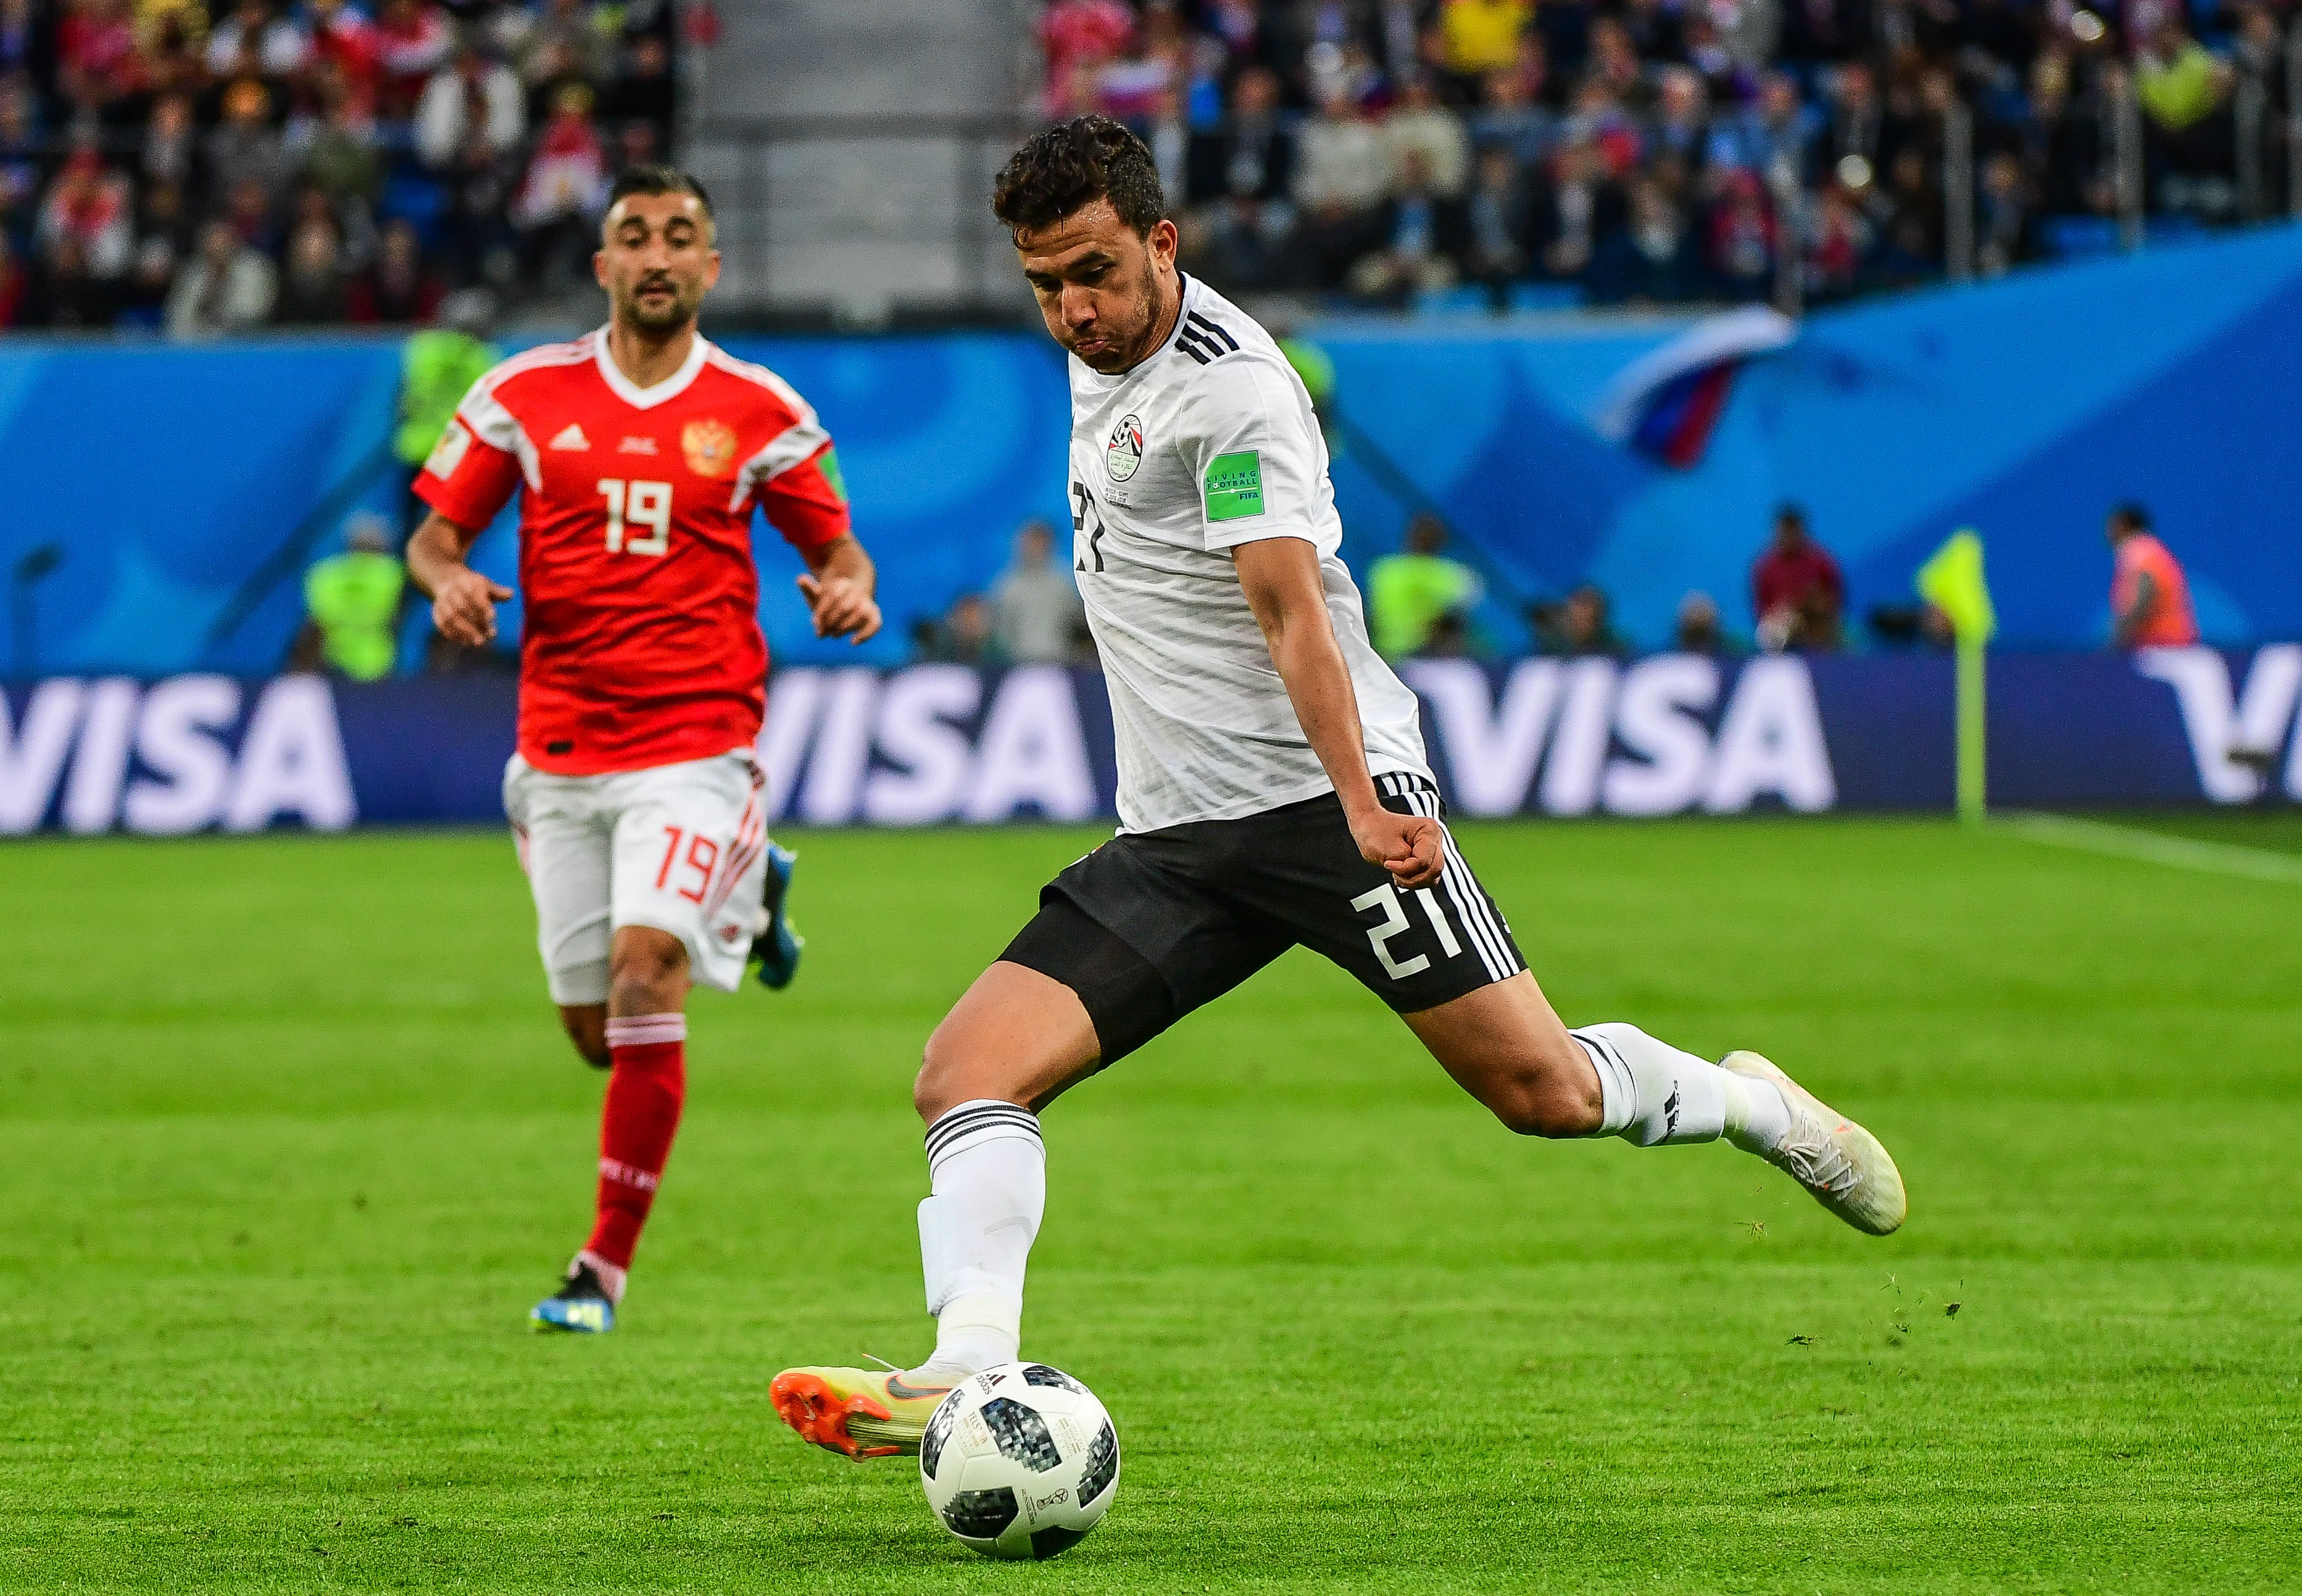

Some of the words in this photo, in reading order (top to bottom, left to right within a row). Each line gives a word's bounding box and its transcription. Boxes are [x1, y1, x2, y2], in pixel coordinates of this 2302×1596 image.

[1207, 471, 1256, 483] LIVING
[1207, 478, 1257, 490] FOOTBALL
[1239, 492, 1258, 501] FIFA
[597, 478, 673, 555] 19
[1405, 654, 1838, 815] VISA
[2134, 644, 2302, 804] V
[655, 825, 719, 905] 19
[1350, 883, 1463, 980] 21
